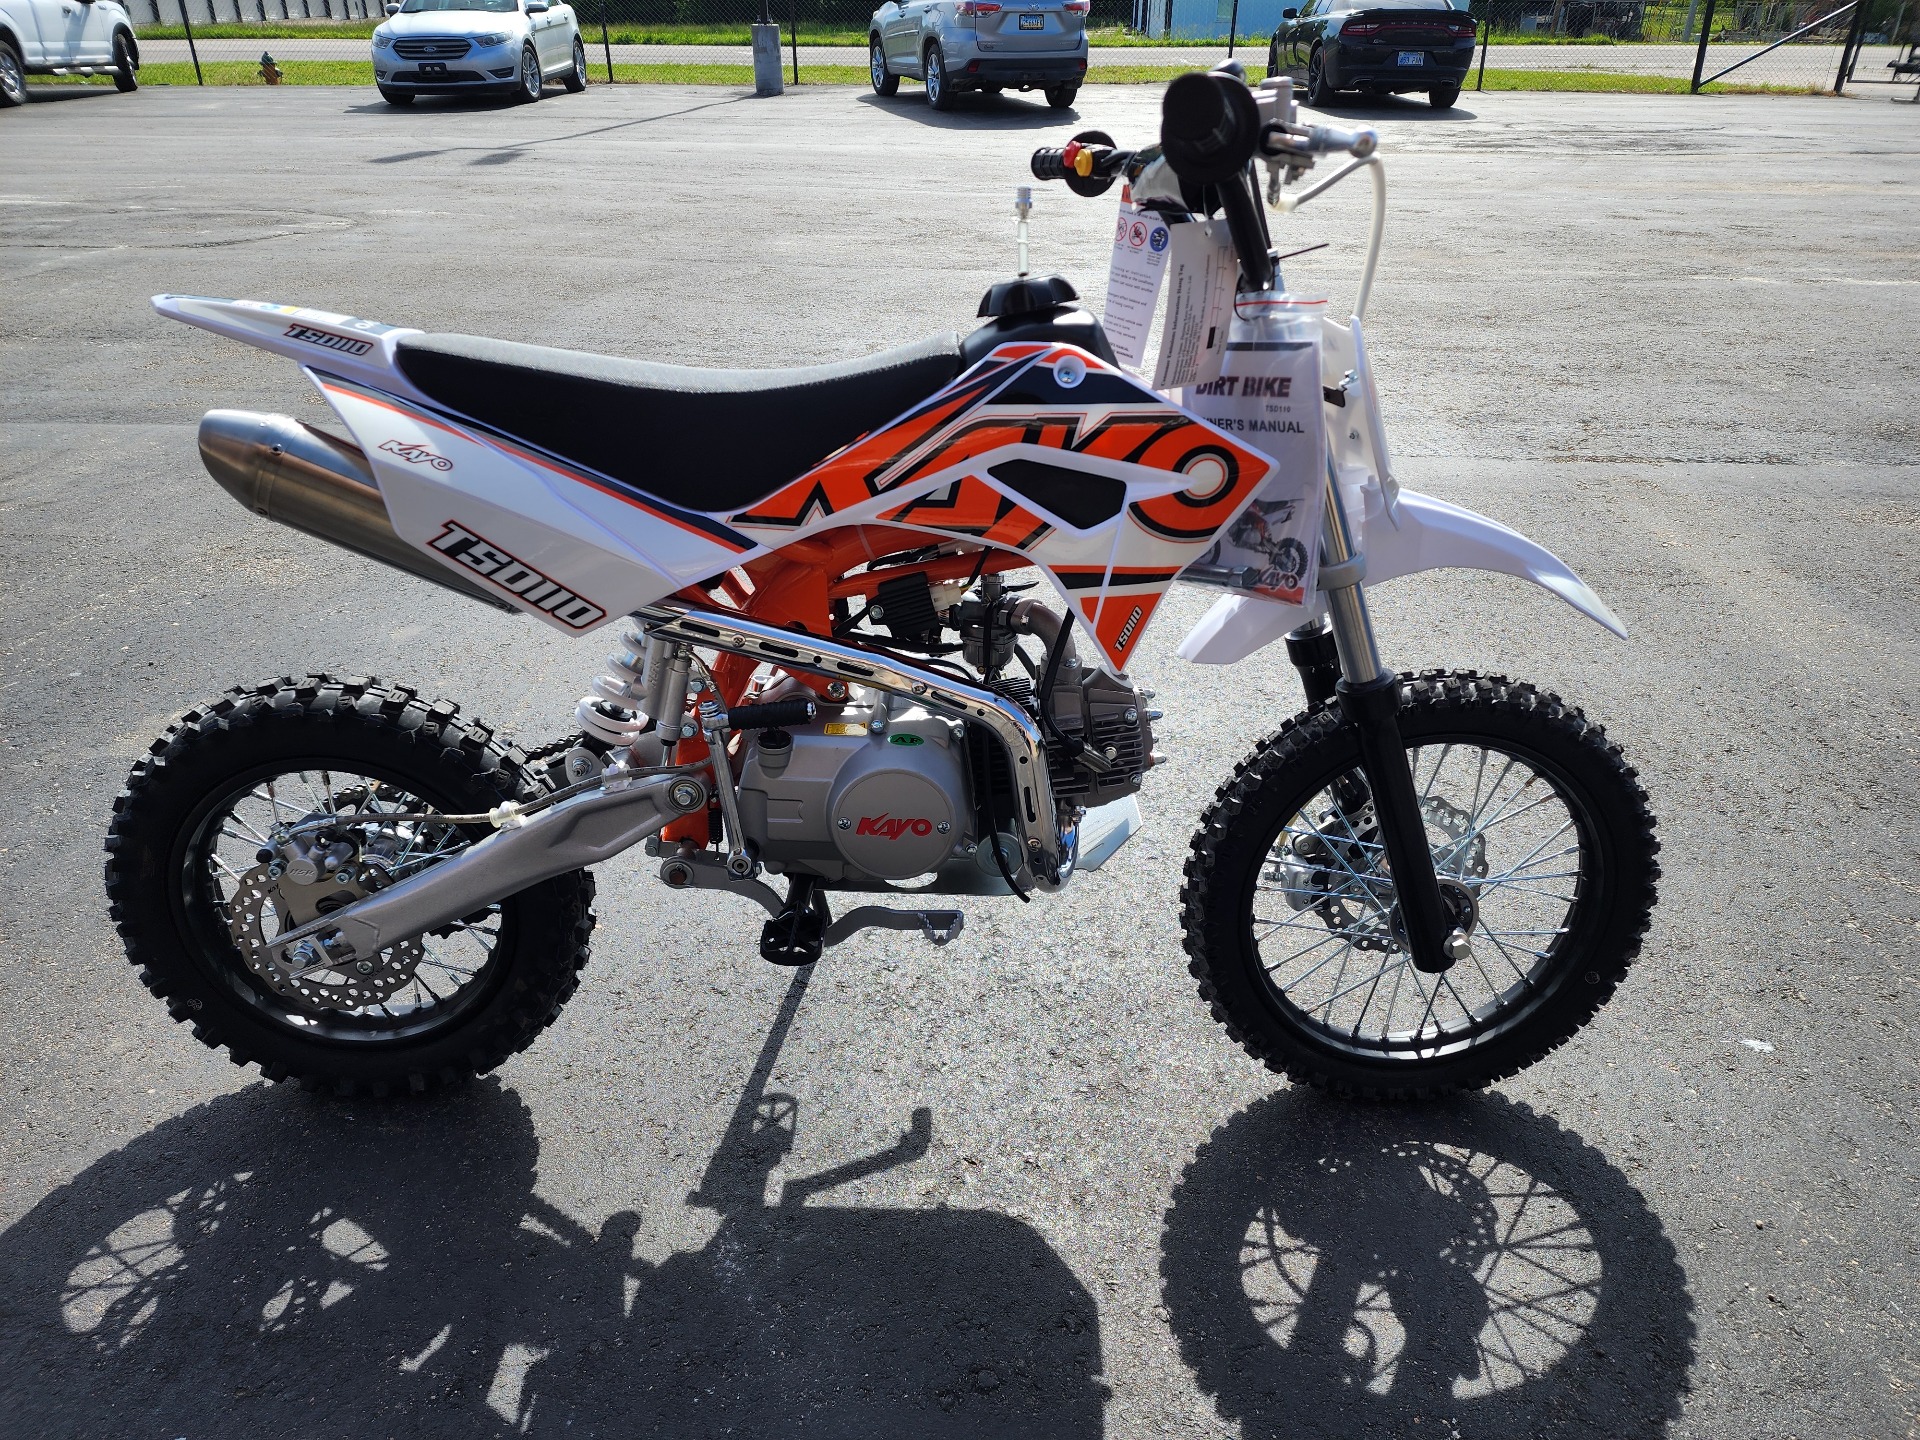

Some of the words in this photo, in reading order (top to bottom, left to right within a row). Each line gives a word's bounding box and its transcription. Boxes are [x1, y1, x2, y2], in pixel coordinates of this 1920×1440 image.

[283, 323, 374, 356] TSD110
[1195, 376, 1240, 396] DIRT
[1241, 376, 1292, 398] BIKE
[1265, 404, 1291, 413] TSD110
[1248, 419, 1305, 434] MANUAL
[378, 440, 454, 472] KAYO
[426, 519, 607, 630] TSD110
[1113, 605, 1143, 652] TSD110
[855, 812, 933, 841] KAYO
